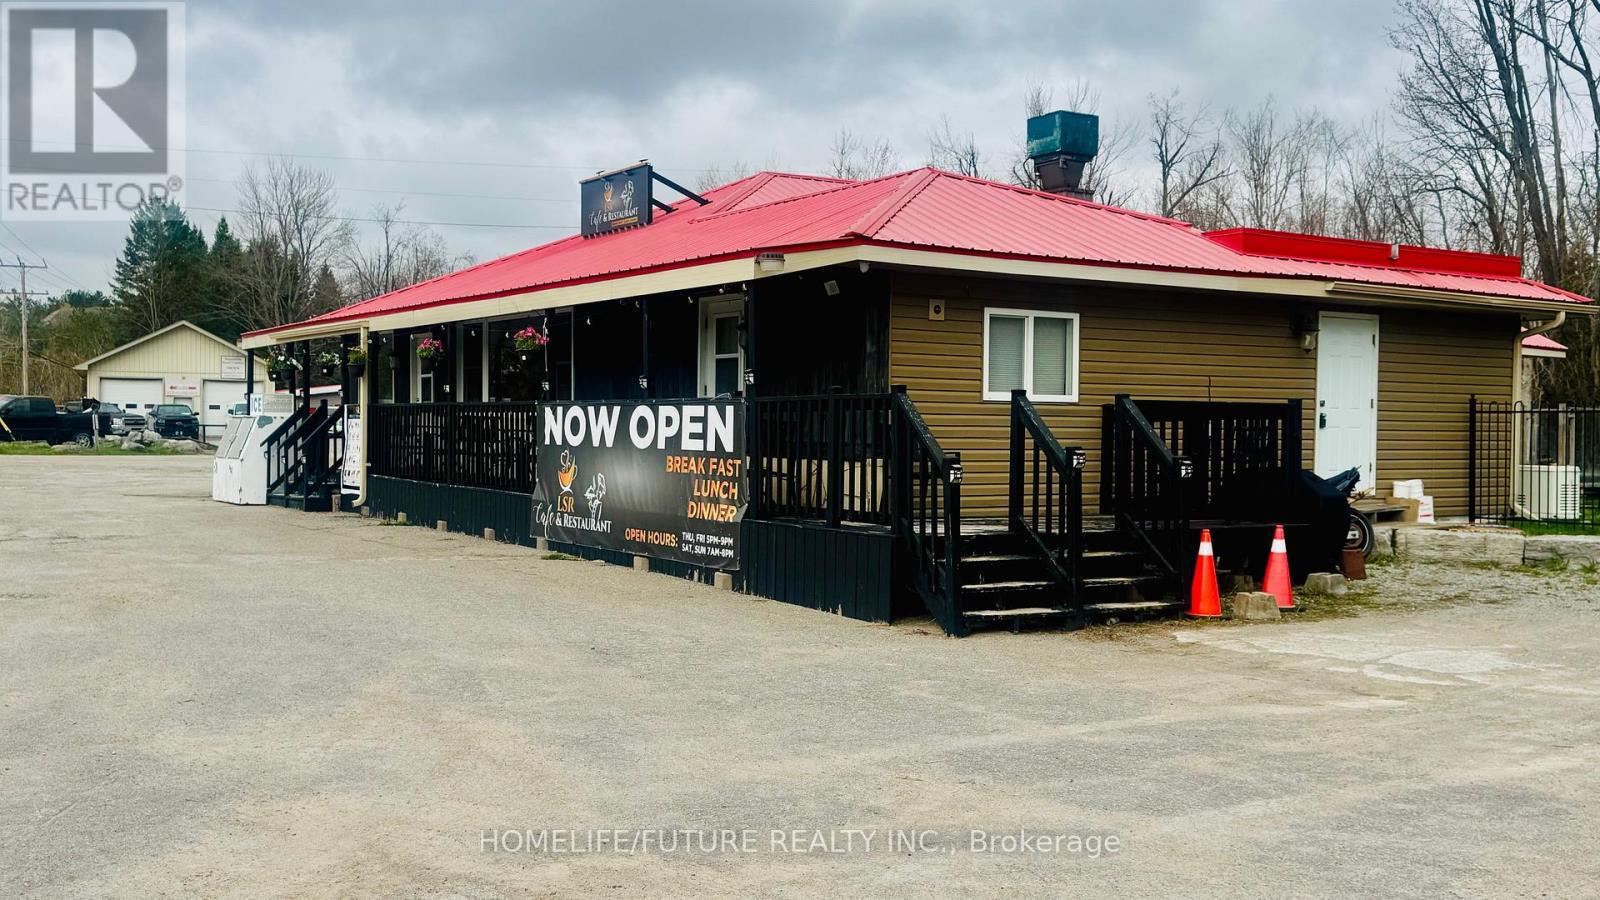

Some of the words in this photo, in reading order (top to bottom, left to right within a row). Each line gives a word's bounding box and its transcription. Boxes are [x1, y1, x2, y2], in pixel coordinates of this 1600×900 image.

[608, 207, 639, 221] RESTAURANT
[544, 405, 621, 448] NOW
[629, 405, 734, 452] OPEN
[666, 455, 706, 475] BREAK
[709, 457, 742, 478] FAST
[693, 478, 738, 500] LUNCH
[557, 495, 575, 513] LSR
[687, 501, 737, 523] DINNER
[555, 512, 563, 527] &
[563, 513, 613, 534] RESTAURANT
[625, 527, 646, 544] OPEN
[647, 529, 678, 548] HOURS:
[682, 531, 695, 544] THU,
[696, 533, 706, 544] FRI
[706, 534, 734, 547] 5PM-9PM
[681, 543, 694, 554] SAT,
[695, 545, 706, 556] SUN
[707, 546, 734, 559] 7AM-8PM
